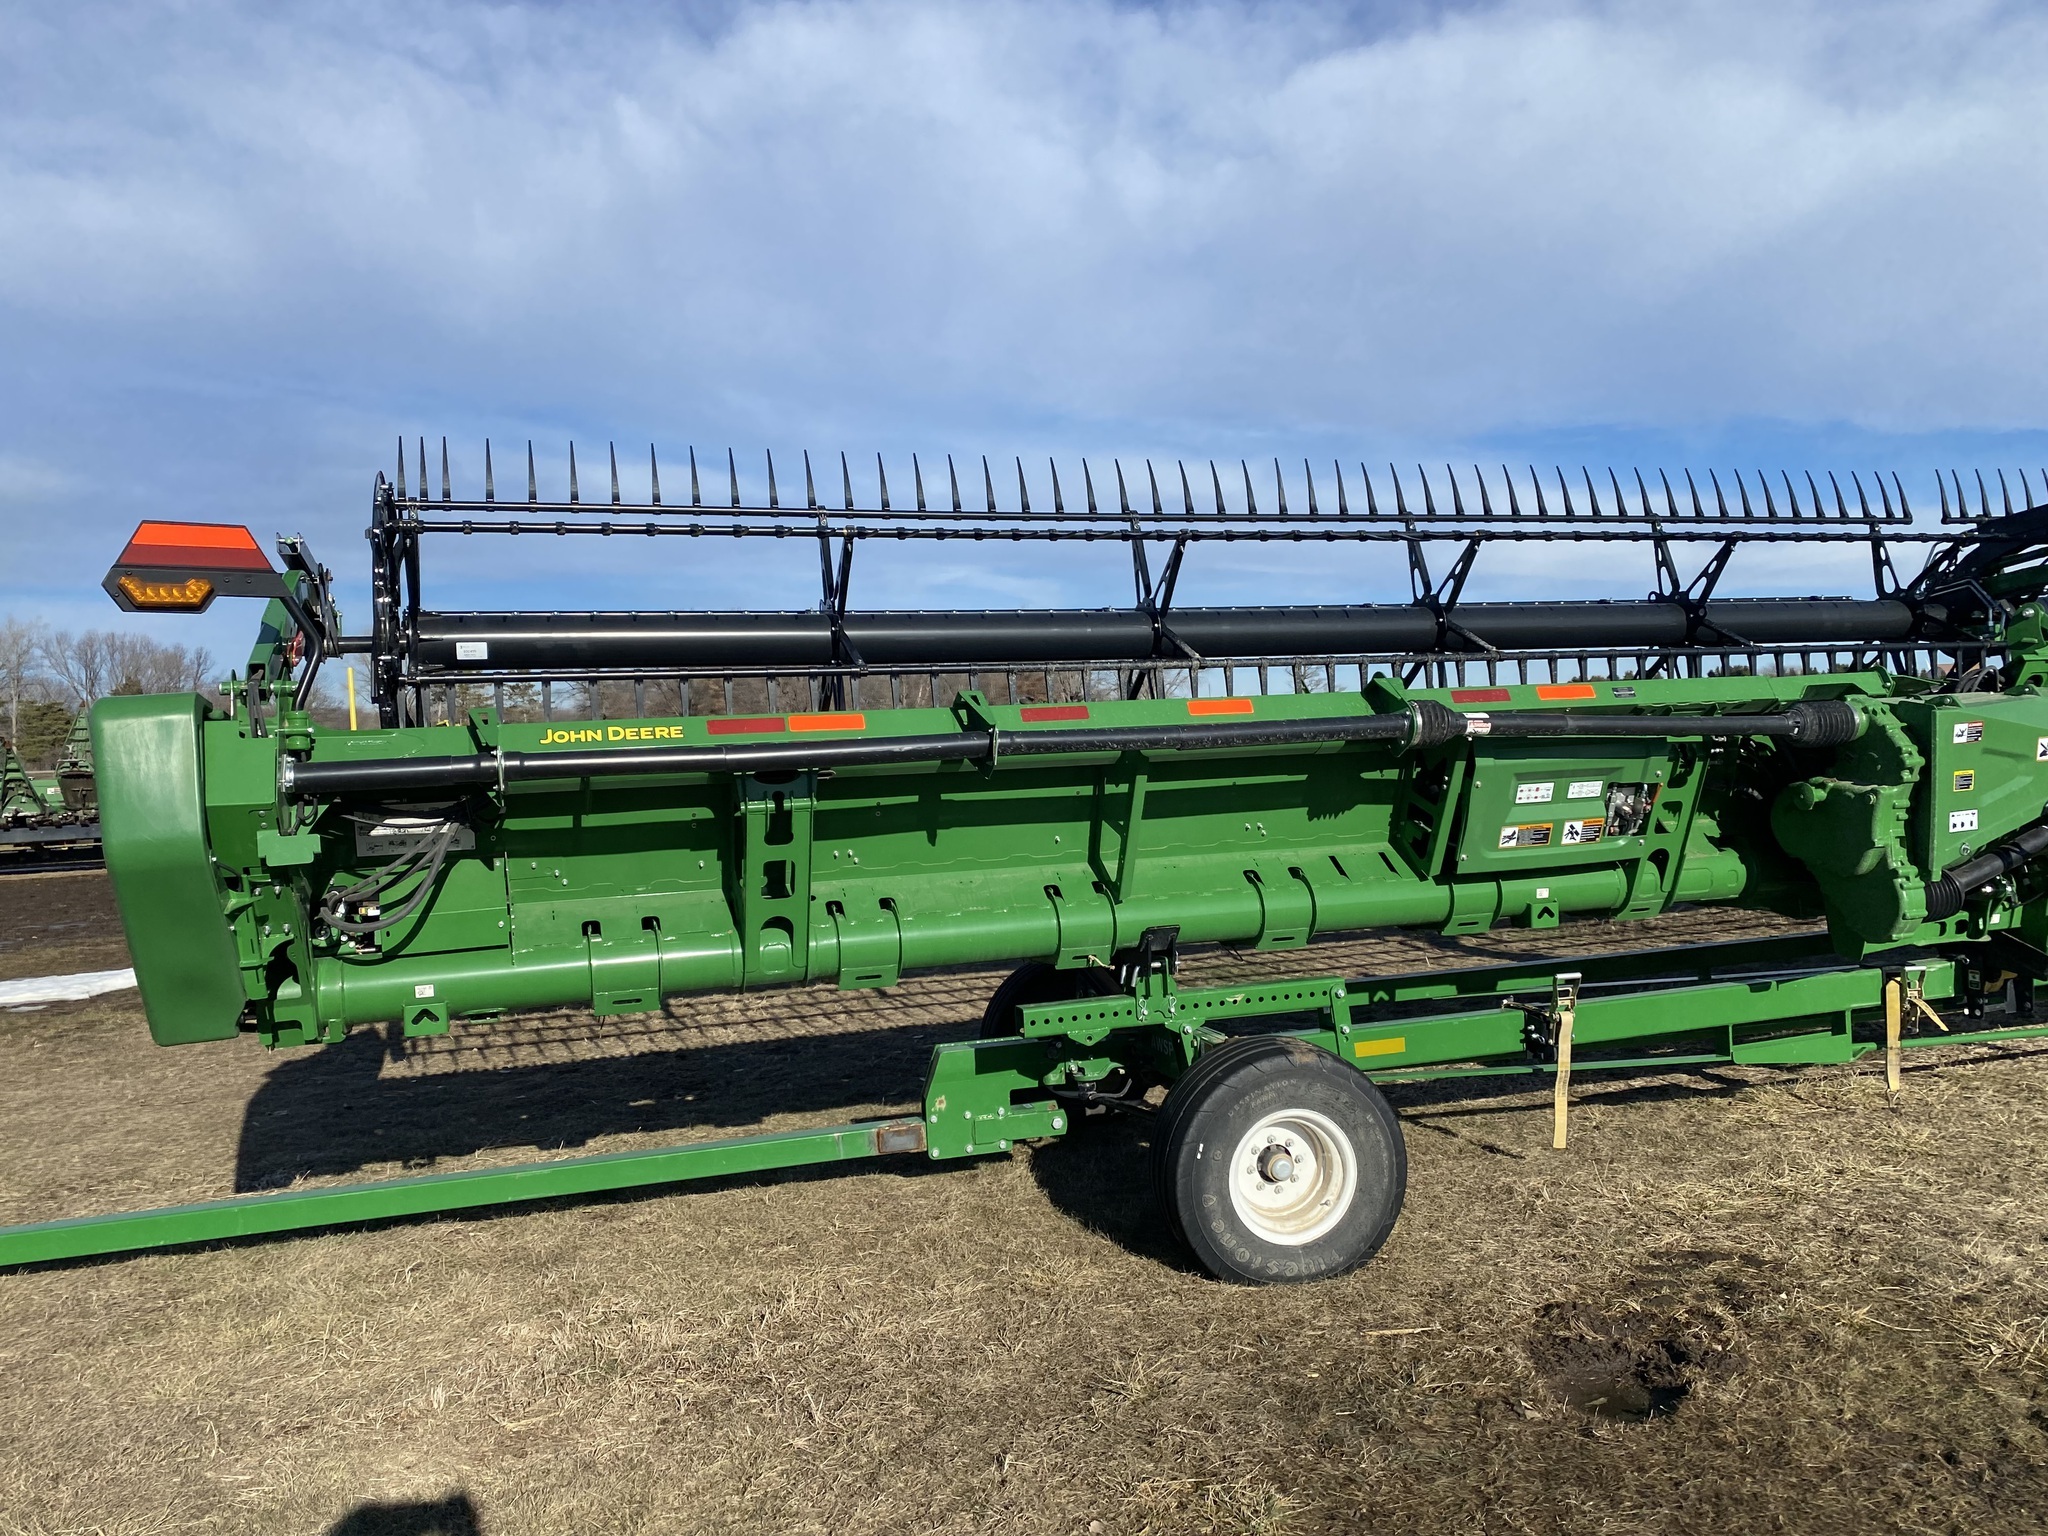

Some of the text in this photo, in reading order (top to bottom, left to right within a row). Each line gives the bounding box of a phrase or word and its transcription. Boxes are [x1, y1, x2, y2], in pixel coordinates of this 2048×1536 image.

[540, 726, 684, 744] JOHN DEERE
[1228, 1078, 1297, 1117] DESTINATION
